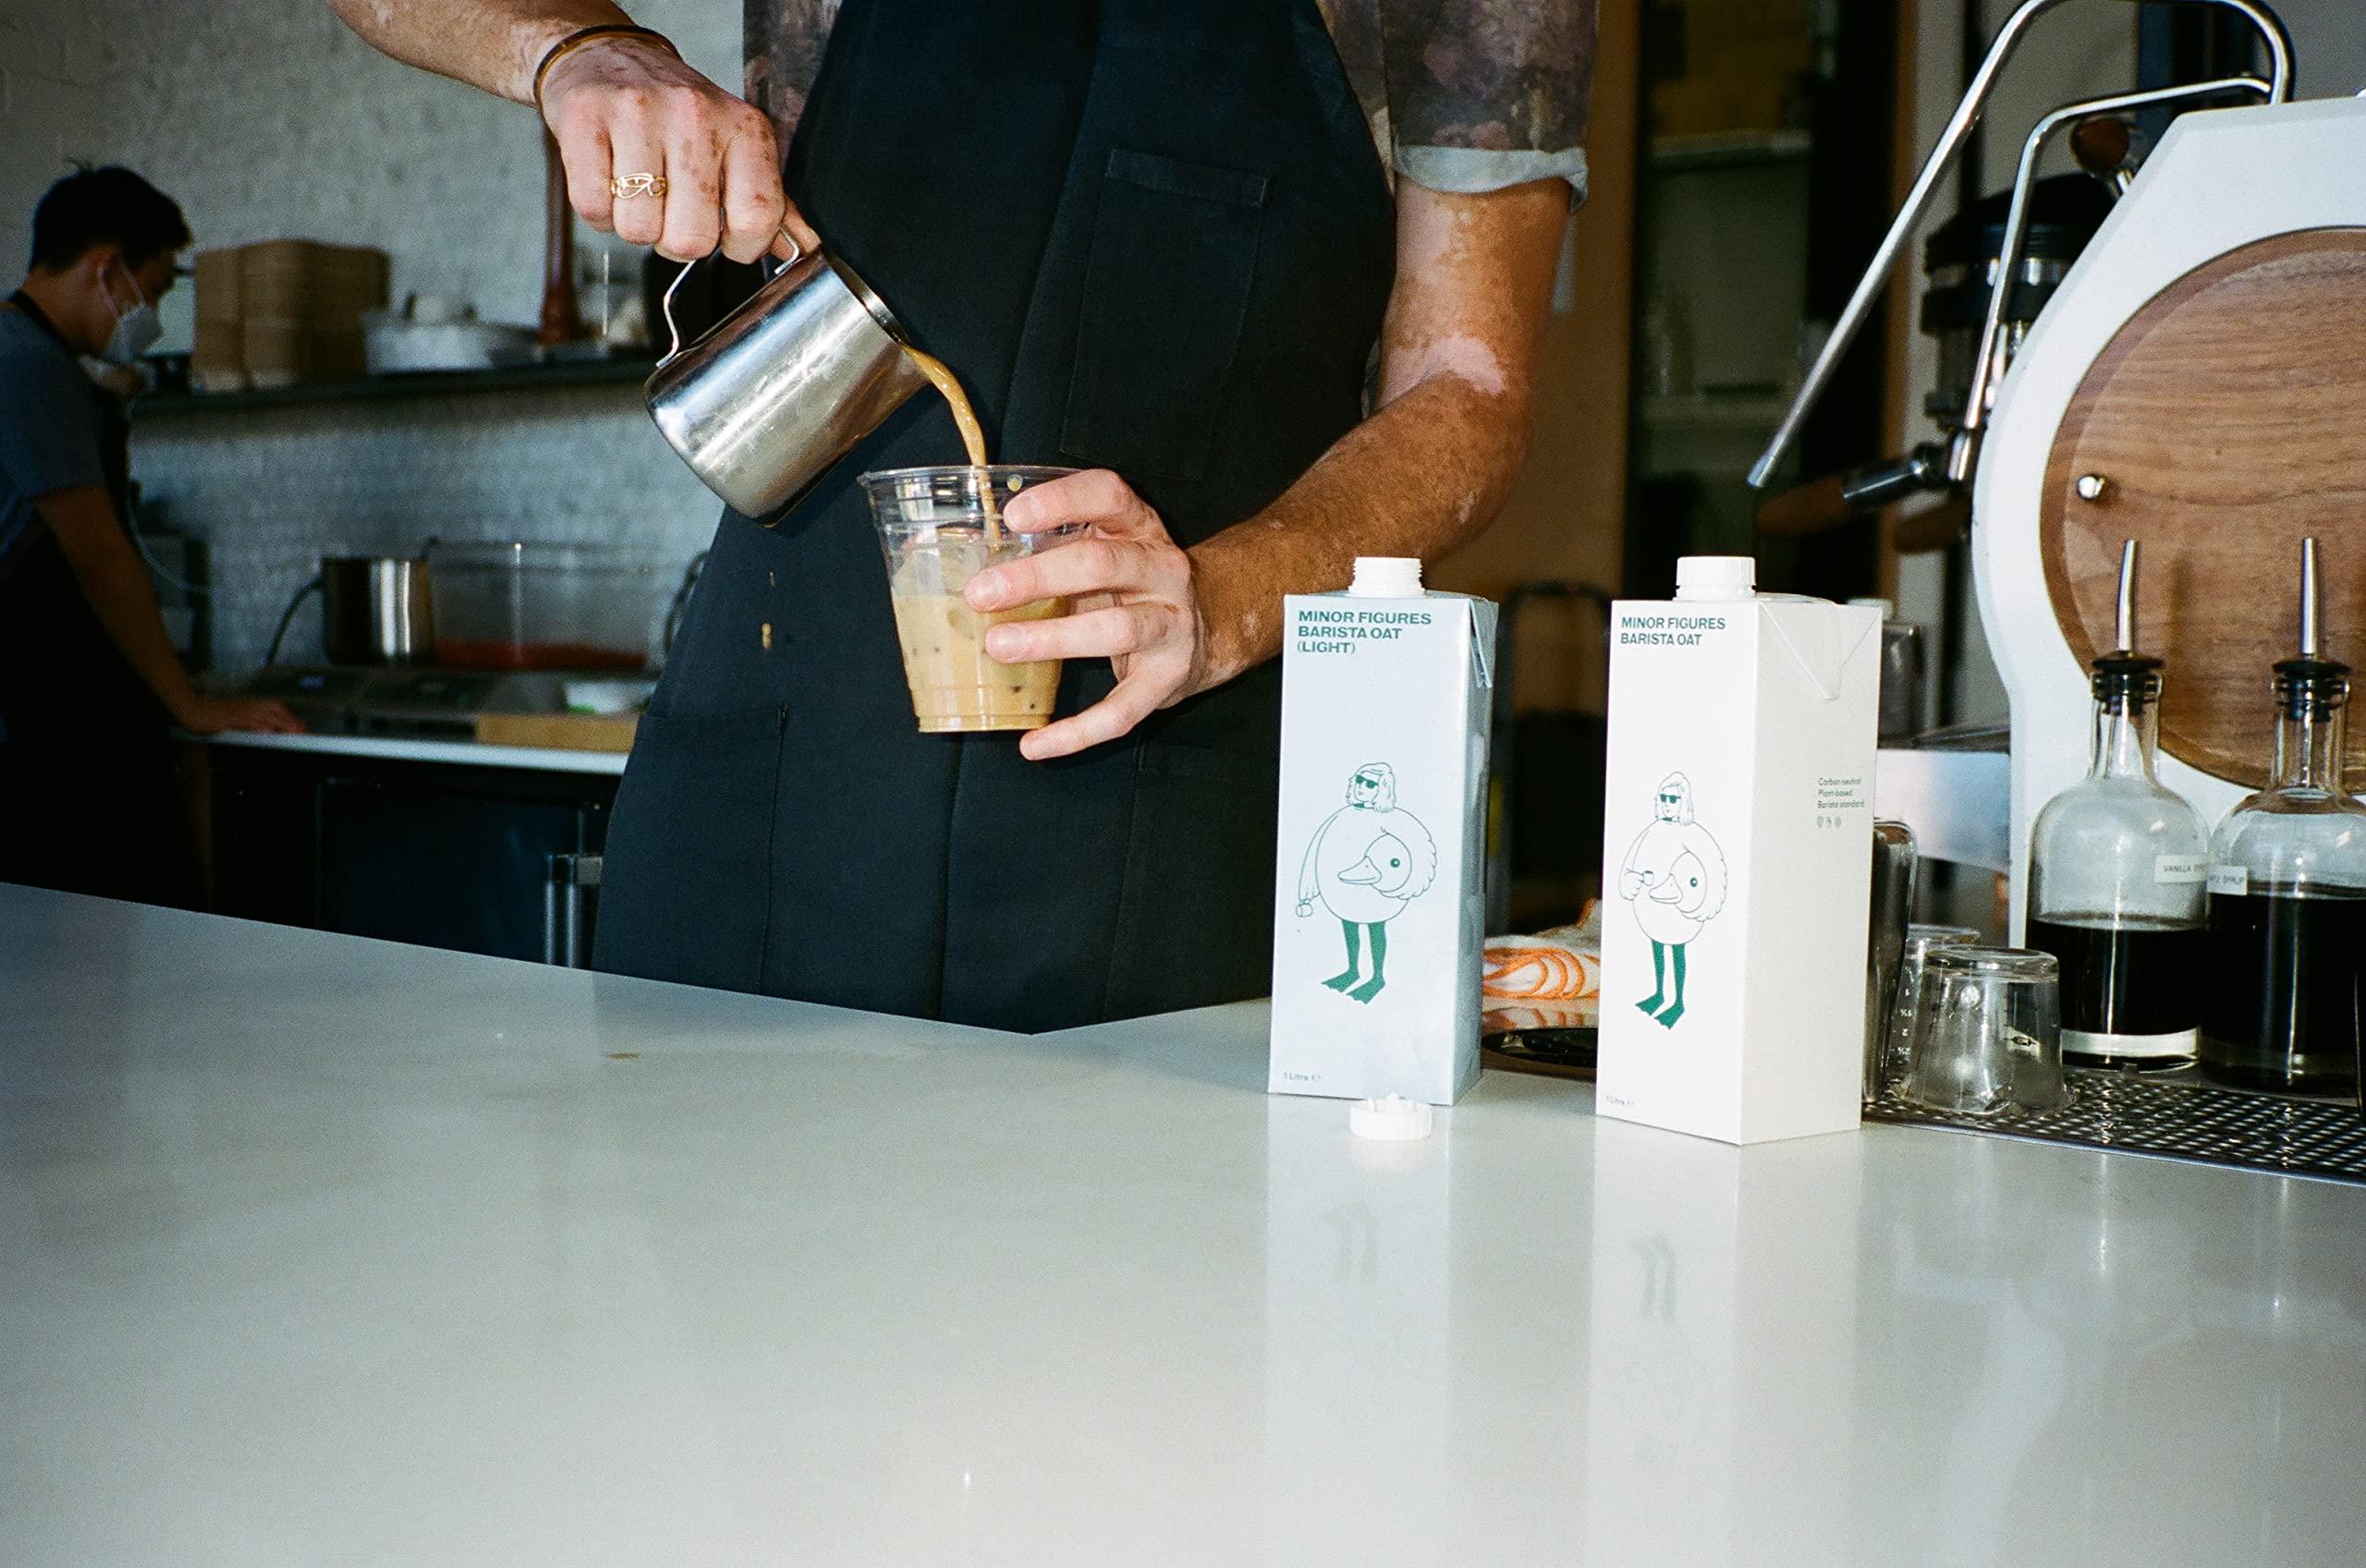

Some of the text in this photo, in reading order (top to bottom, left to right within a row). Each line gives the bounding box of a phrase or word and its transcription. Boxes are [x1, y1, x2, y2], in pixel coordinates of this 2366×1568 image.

[1299, 611, 1432, 625] MINOR FIGURES
[1621, 617, 1726, 629] MINOR FIGURES
[1299, 626, 1402, 639] BARISTA OAT
[1621, 633, 1702, 645] BARISTA OAT
[1297, 641, 1356, 654] (LIGHT)
[1818, 776, 1861, 785] Carbon neutral
[1818, 788, 1852, 797] Plant-based
[1818, 799, 1864, 808] Barista standard
